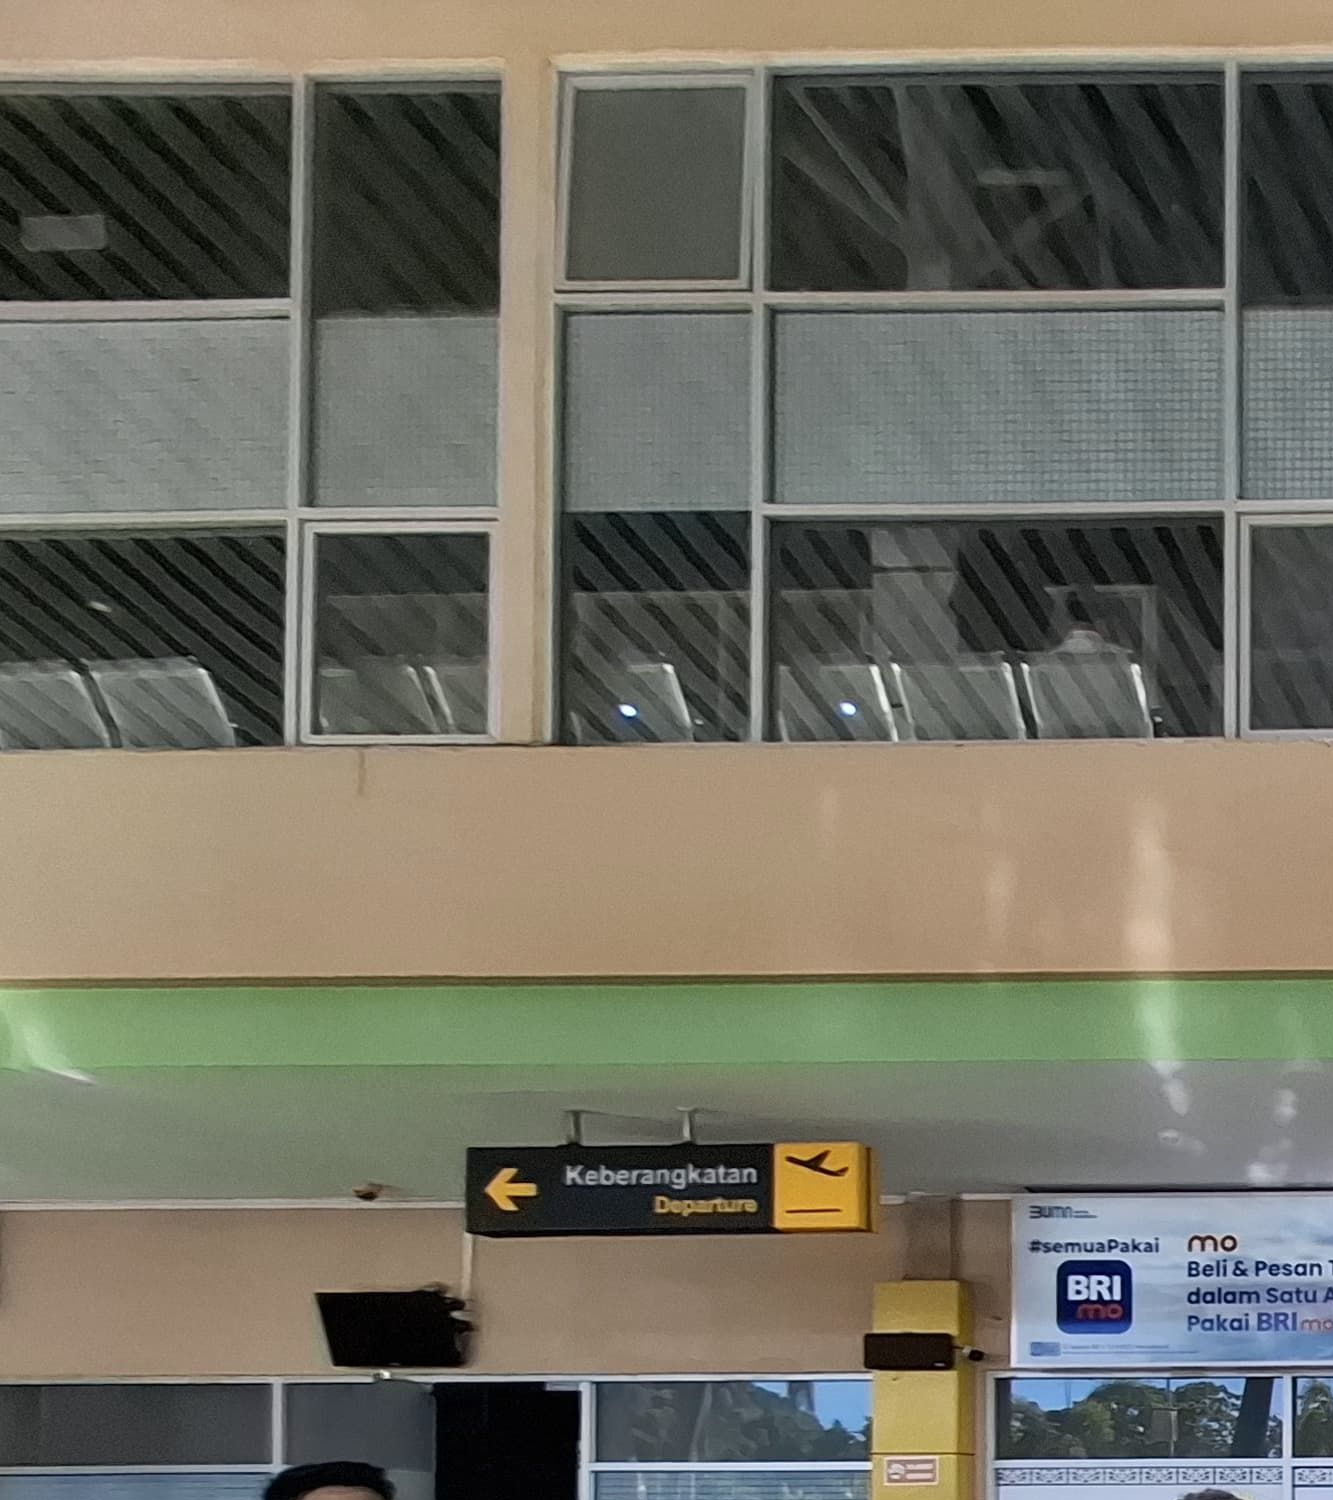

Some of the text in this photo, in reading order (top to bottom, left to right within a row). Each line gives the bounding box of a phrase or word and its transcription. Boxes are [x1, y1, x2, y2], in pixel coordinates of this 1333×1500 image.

[565, 1165, 757, 1189] Keberangkatan
[654, 1196, 758, 1216] Departure
[1029, 1237, 1160, 1254] #semuaPakai
[1187, 1234, 1239, 1253] mo
[1187, 1259, 1228, 1278] Beli
[1233, 1261, 1249, 1277] &
[1254, 1260, 1323, 1278] Pesan
[1067, 1275, 1122, 1301] BRI
[1187, 1287, 1259, 1305] dalam
[1266, 1287, 1318, 1305] Satu
[1187, 1313, 1250, 1332] Pakai
